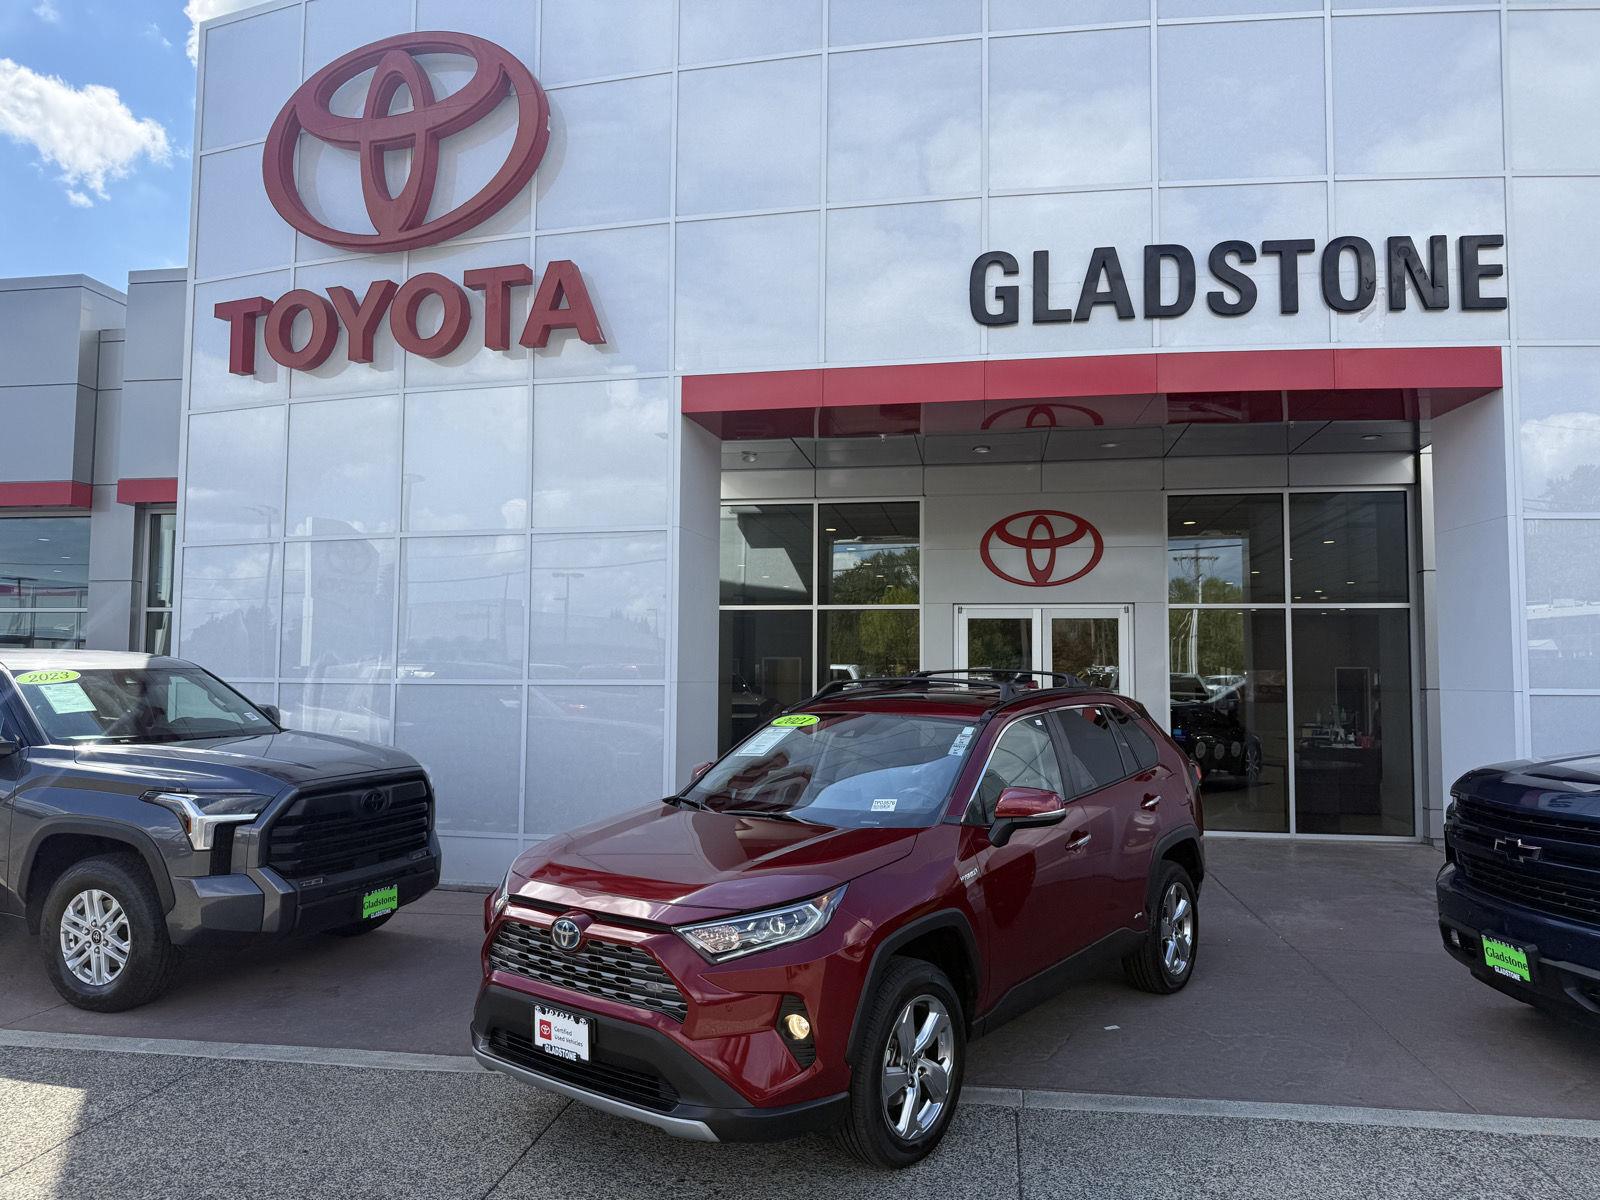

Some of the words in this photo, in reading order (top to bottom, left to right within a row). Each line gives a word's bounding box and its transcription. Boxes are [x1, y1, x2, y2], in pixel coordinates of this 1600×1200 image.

[969, 234, 1508, 327] GLADSTONE
[214, 260, 607, 376] TOYOTA
[28, 671, 70, 683] 2023
[363, 895, 397, 911] Gladstone
[1485, 946, 1529, 971] Gladstone
[544, 1007, 576, 1022] TOYOTA
[544, 1044, 578, 1062] GLADSTONE
